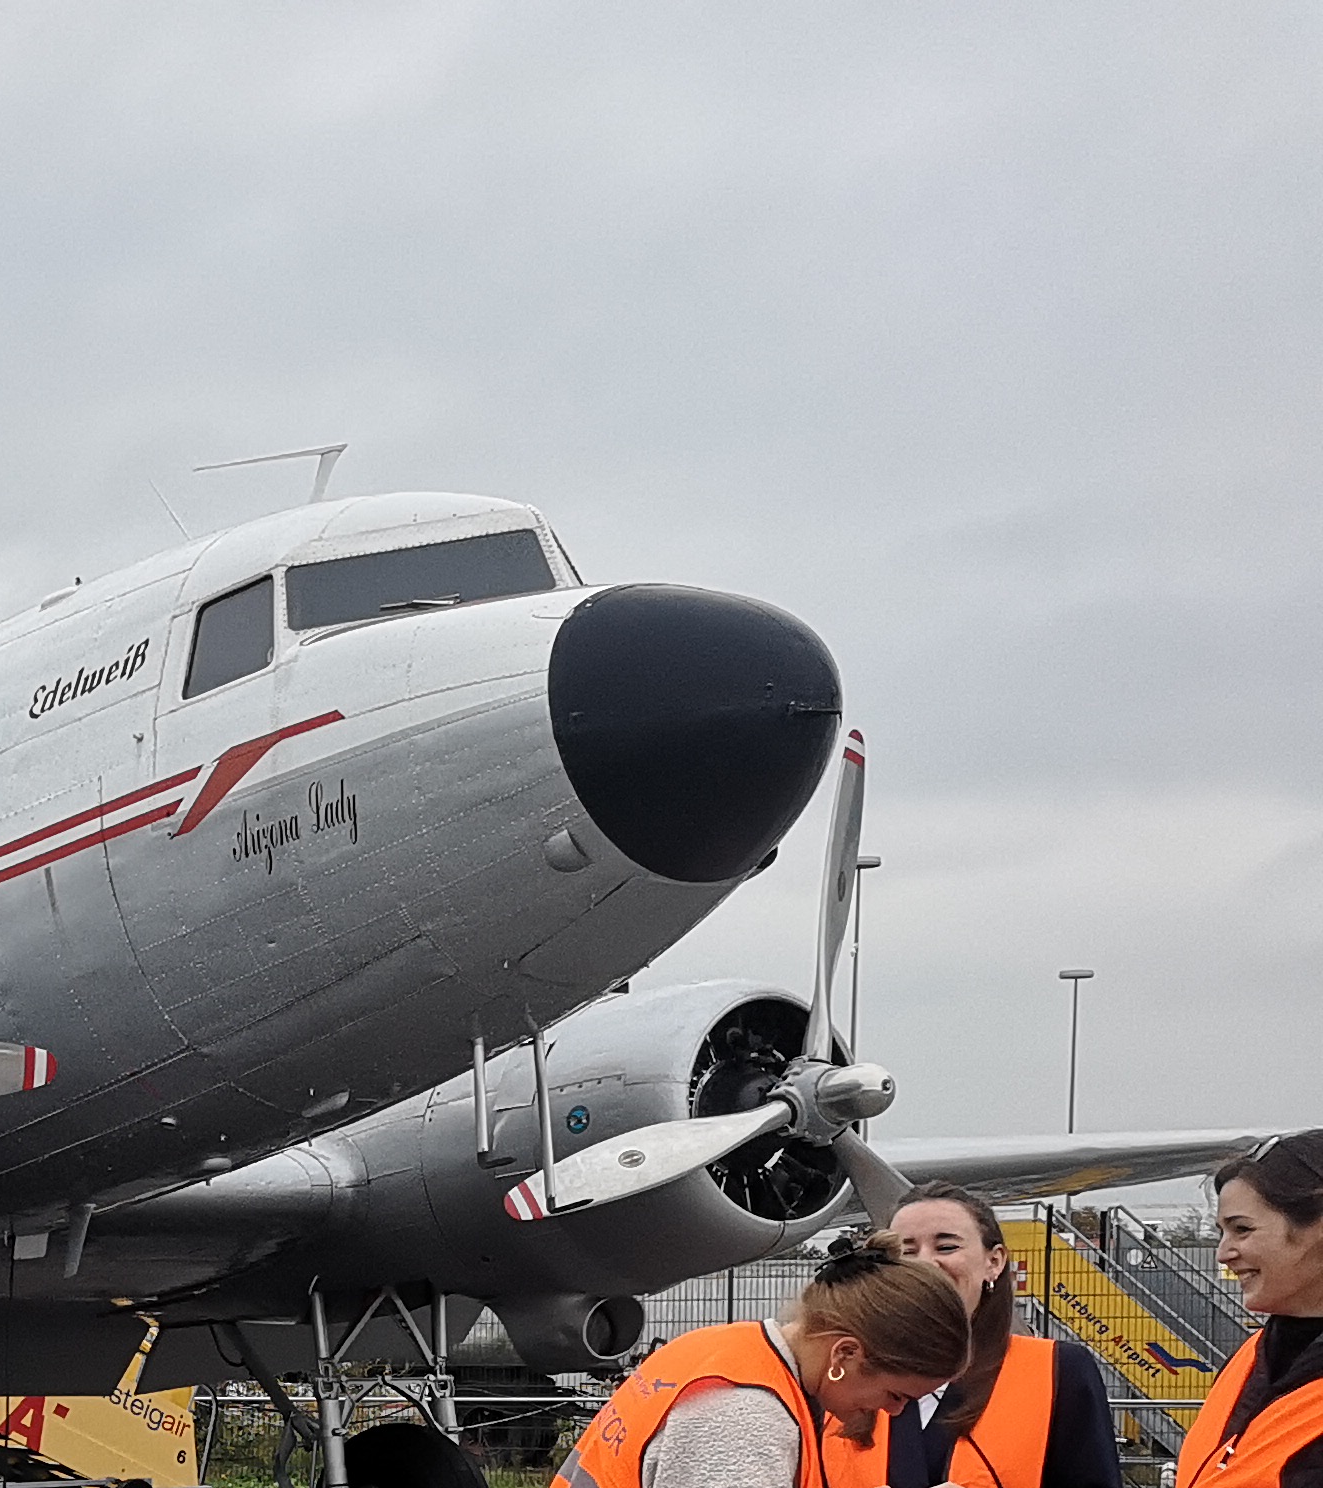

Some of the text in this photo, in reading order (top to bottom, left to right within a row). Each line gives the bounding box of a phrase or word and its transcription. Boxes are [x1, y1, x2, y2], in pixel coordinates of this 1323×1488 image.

[28, 636, 150, 720] Edelweiß
[232, 778, 359, 876] Arizona Lady
[1052, 1281, 1161, 1378] Salzburg Airport
[102, 1387, 191, 1438] steigair
[176, 1449, 187, 1465] 6
